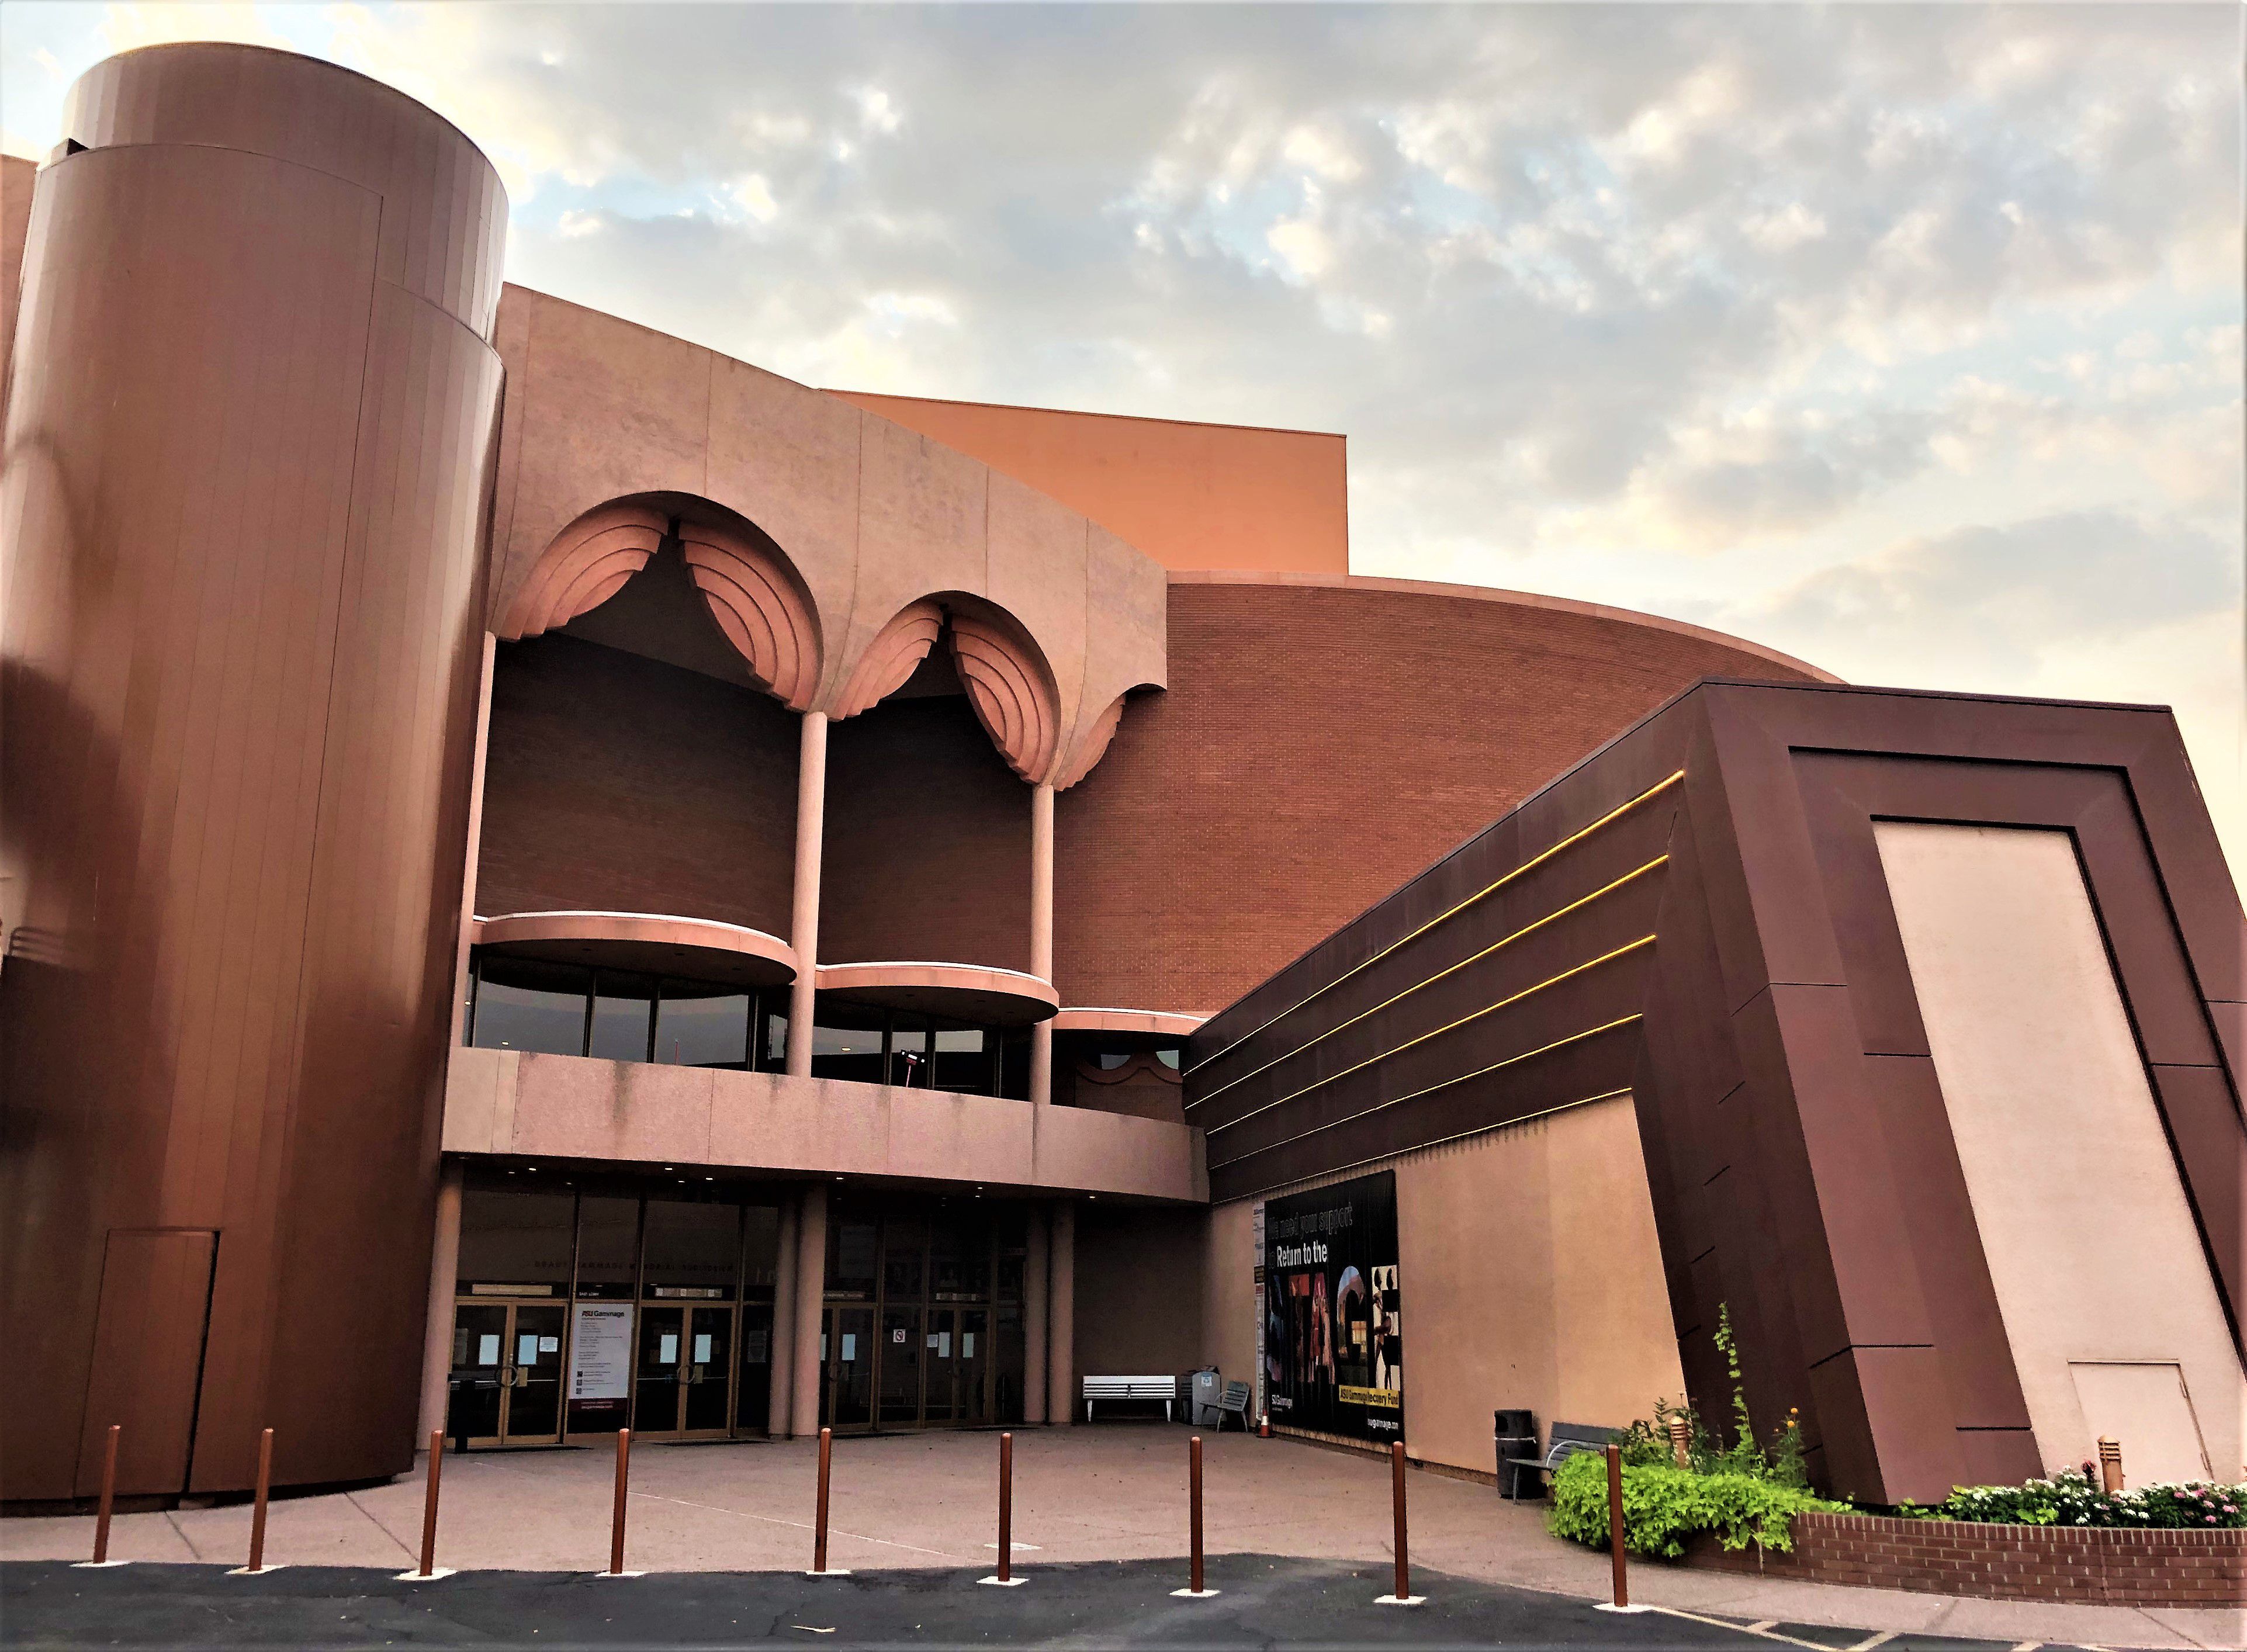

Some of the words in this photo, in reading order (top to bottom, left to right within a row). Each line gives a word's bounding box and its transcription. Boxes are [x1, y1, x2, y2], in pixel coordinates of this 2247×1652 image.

[1318, 1201, 1353, 1235] support
[1277, 1245, 1301, 1267] Return
[1303, 1242, 1312, 1265] to
[1313, 1239, 1328, 1263] the
[594, 1310, 625, 1318] Gammage
